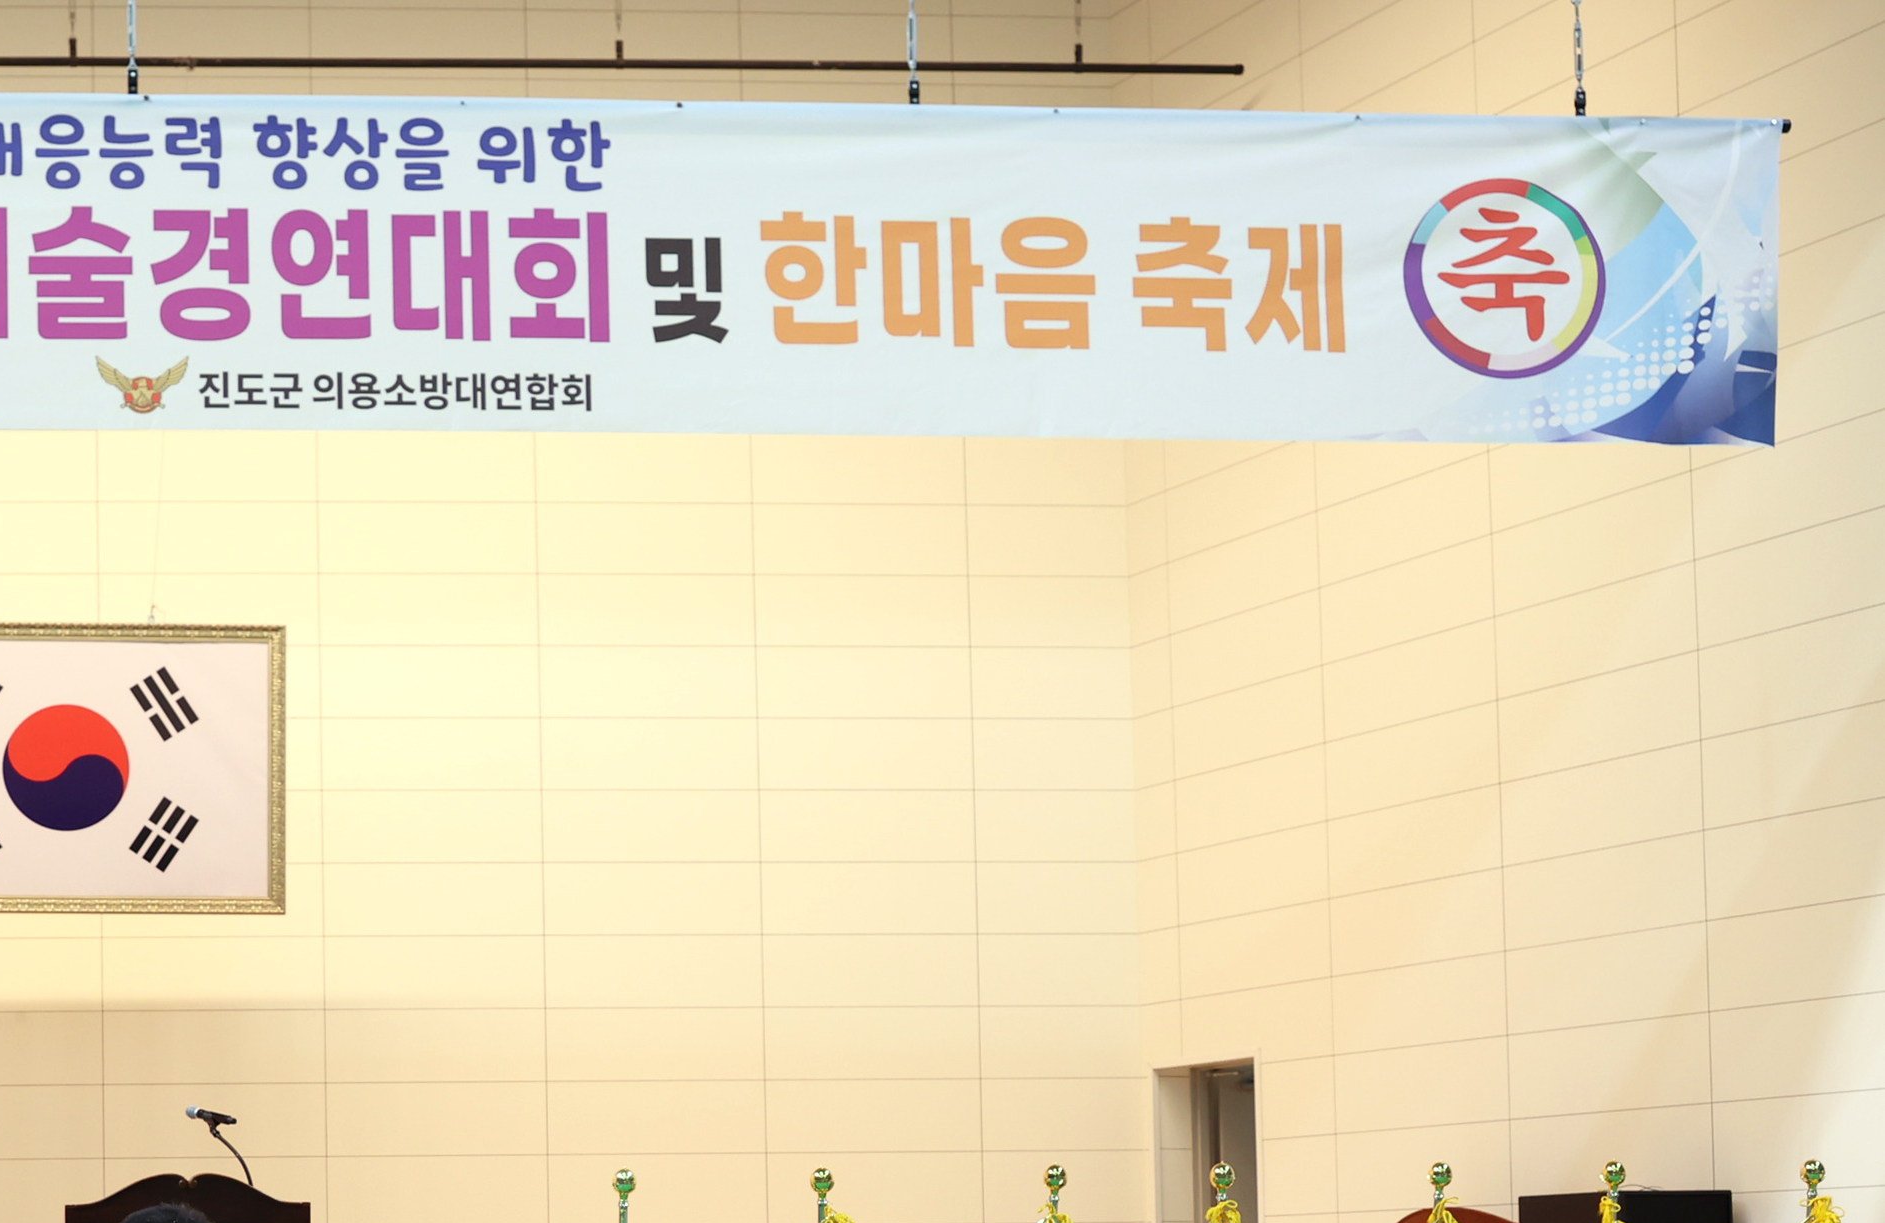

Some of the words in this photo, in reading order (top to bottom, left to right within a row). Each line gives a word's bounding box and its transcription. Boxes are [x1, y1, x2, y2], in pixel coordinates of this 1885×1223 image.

[253, 115, 449, 191] 향상을
[477, 118, 611, 192] 위한
[645, 237, 729, 344] 및
[760, 211, 1096, 349] 한마음
[1133, 217, 1346, 353] 축제
[1437, 206, 1570, 343] 축
[199, 371, 303, 409] 진도군
[313, 372, 593, 411] 의용소방대연합회
